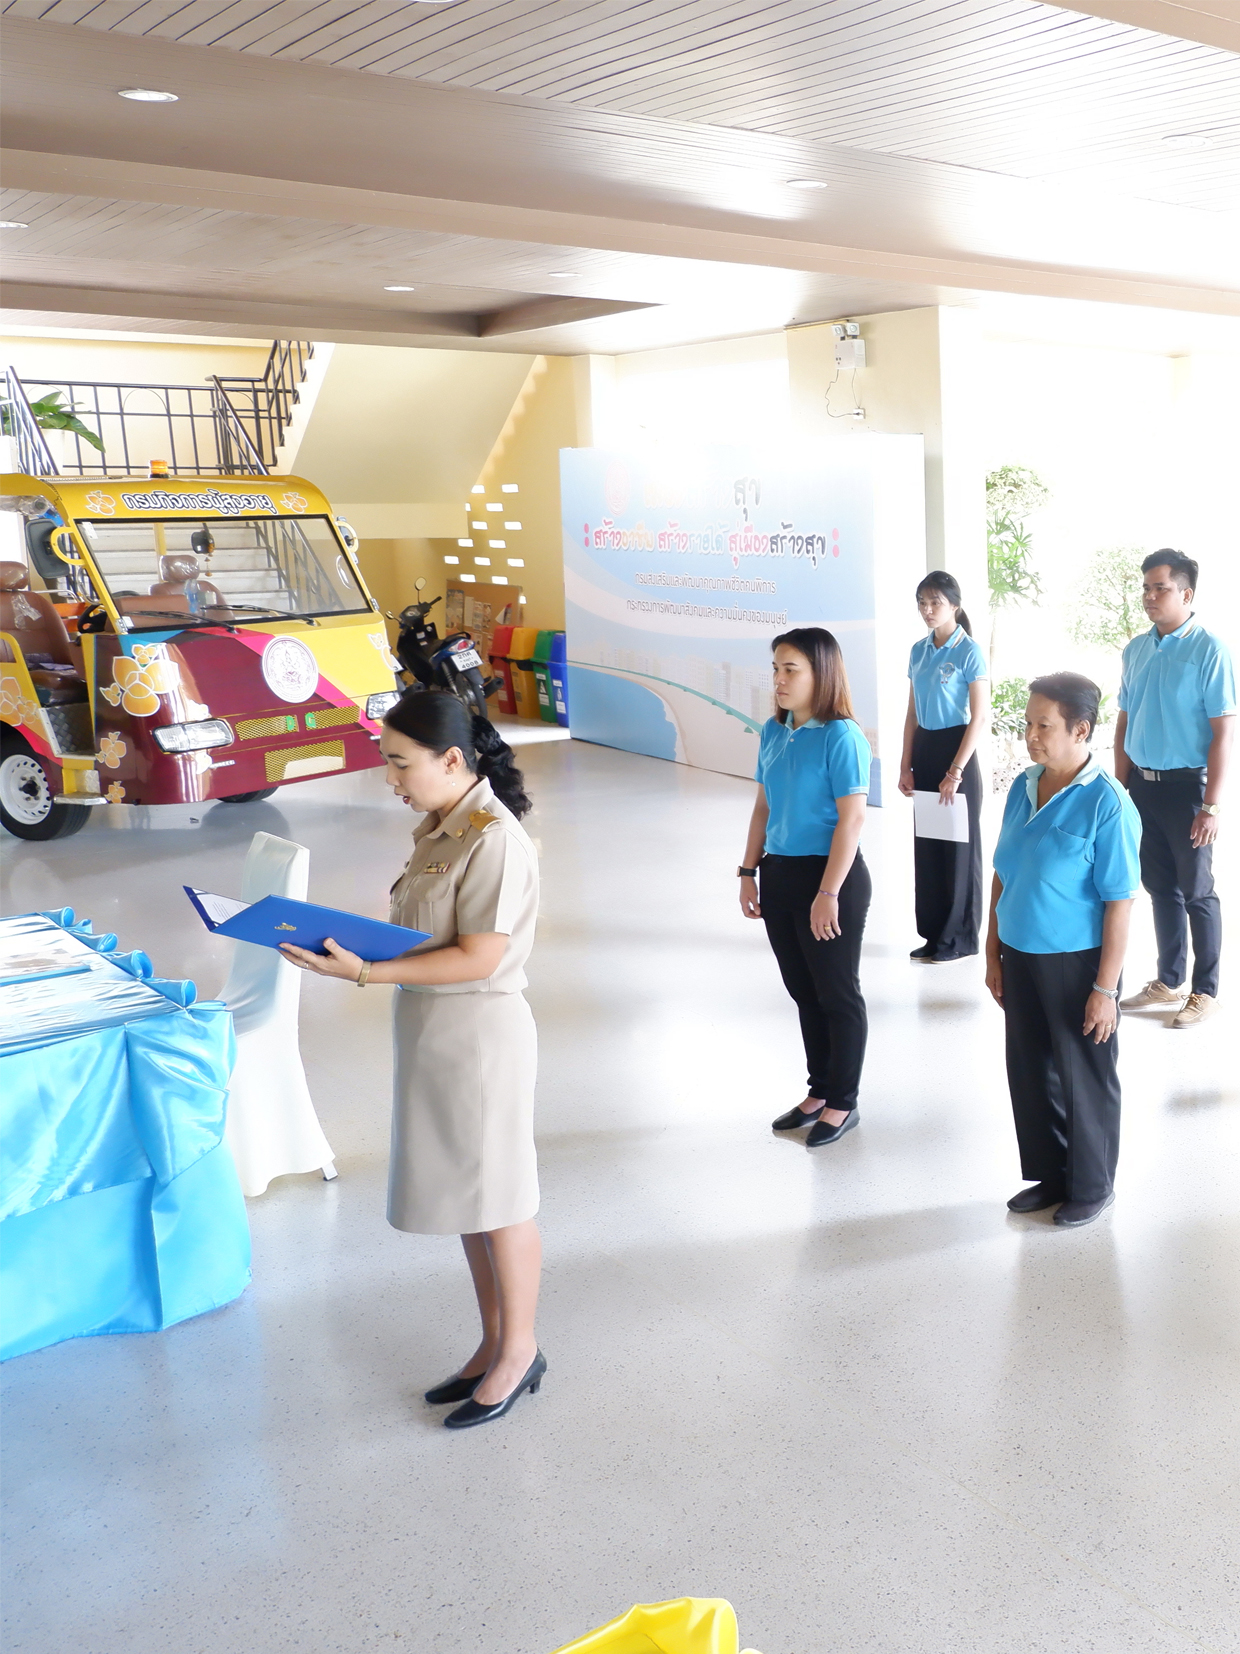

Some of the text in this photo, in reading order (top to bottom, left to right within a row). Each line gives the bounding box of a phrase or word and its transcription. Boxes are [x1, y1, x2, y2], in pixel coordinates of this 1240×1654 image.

[121, 488, 278, 515] กรมกิจการผู้สูงอายุ
[593, 519, 827, 568] สร้างอาชีพ สร้างรายได้ สู่เมืองสร้างสุข
[634, 571, 777, 595] กรมส่งเสริมและพัฒนาคุณภาพชีวิตคนพิการ
[627, 599, 788, 628] กระทรวงการพัฒนาสังคมและความมั่นคงของมนุษย์
